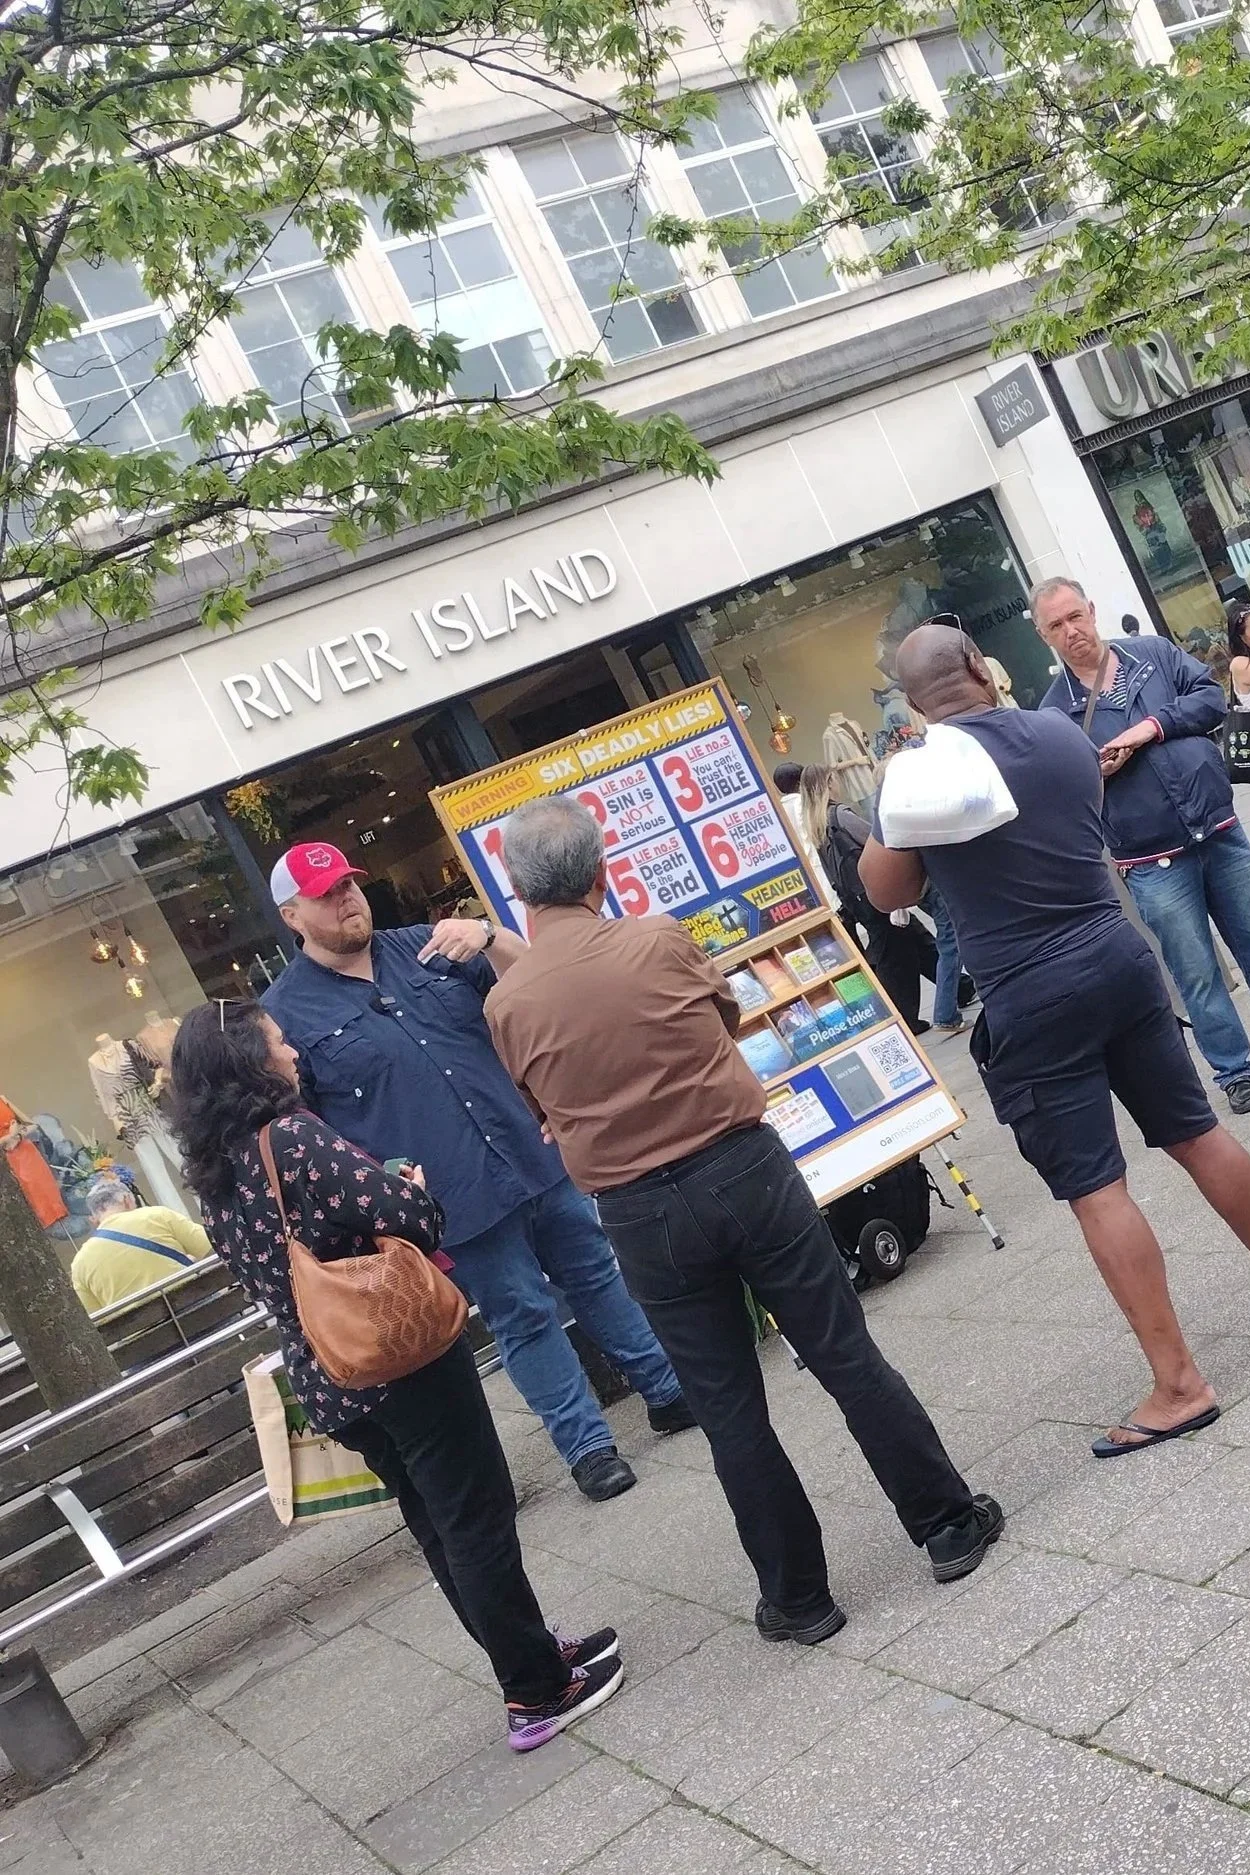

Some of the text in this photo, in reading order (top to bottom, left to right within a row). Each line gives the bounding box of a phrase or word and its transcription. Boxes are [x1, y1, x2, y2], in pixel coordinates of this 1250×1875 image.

[991, 380, 1023, 413] RIVER
[996, 398, 1035, 434] ISLAND
[222, 548, 619, 731] RIVER ISLAND
[456, 699, 715, 820] WARNING SIX DEADLY LIES!
[685, 734, 730, 762] LIE no.3
[693, 750, 738, 777] You can't
[697, 760, 743, 785] trust the
[598, 769, 646, 797] LIE no.2
[662, 756, 704, 813] 3
[702, 770, 751, 805] BIBLE
[606, 787, 654, 815] SIN is
[618, 799, 654, 829] NOT
[723, 801, 768, 827] LIE no.6
[359, 830, 376, 845] LIFT
[620, 815, 667, 841] serious
[728, 813, 774, 841] HEAVEN
[633, 836, 679, 866] LIE no.5
[702, 822, 740, 879] 6
[741, 833, 772, 867] good
[752, 843, 788, 867] people
[639, 851, 688, 882] Death
[657, 874, 674, 886] the
[608, 857, 650, 916] 5
[657, 869, 700, 904] end
[751, 872, 804, 906] HEAVEN
[769, 898, 807, 924] HELL
[692, 914, 722, 941] died
[809, 1003, 876, 1047] Please take!
[879, 1104, 945, 1148] oamission.com
